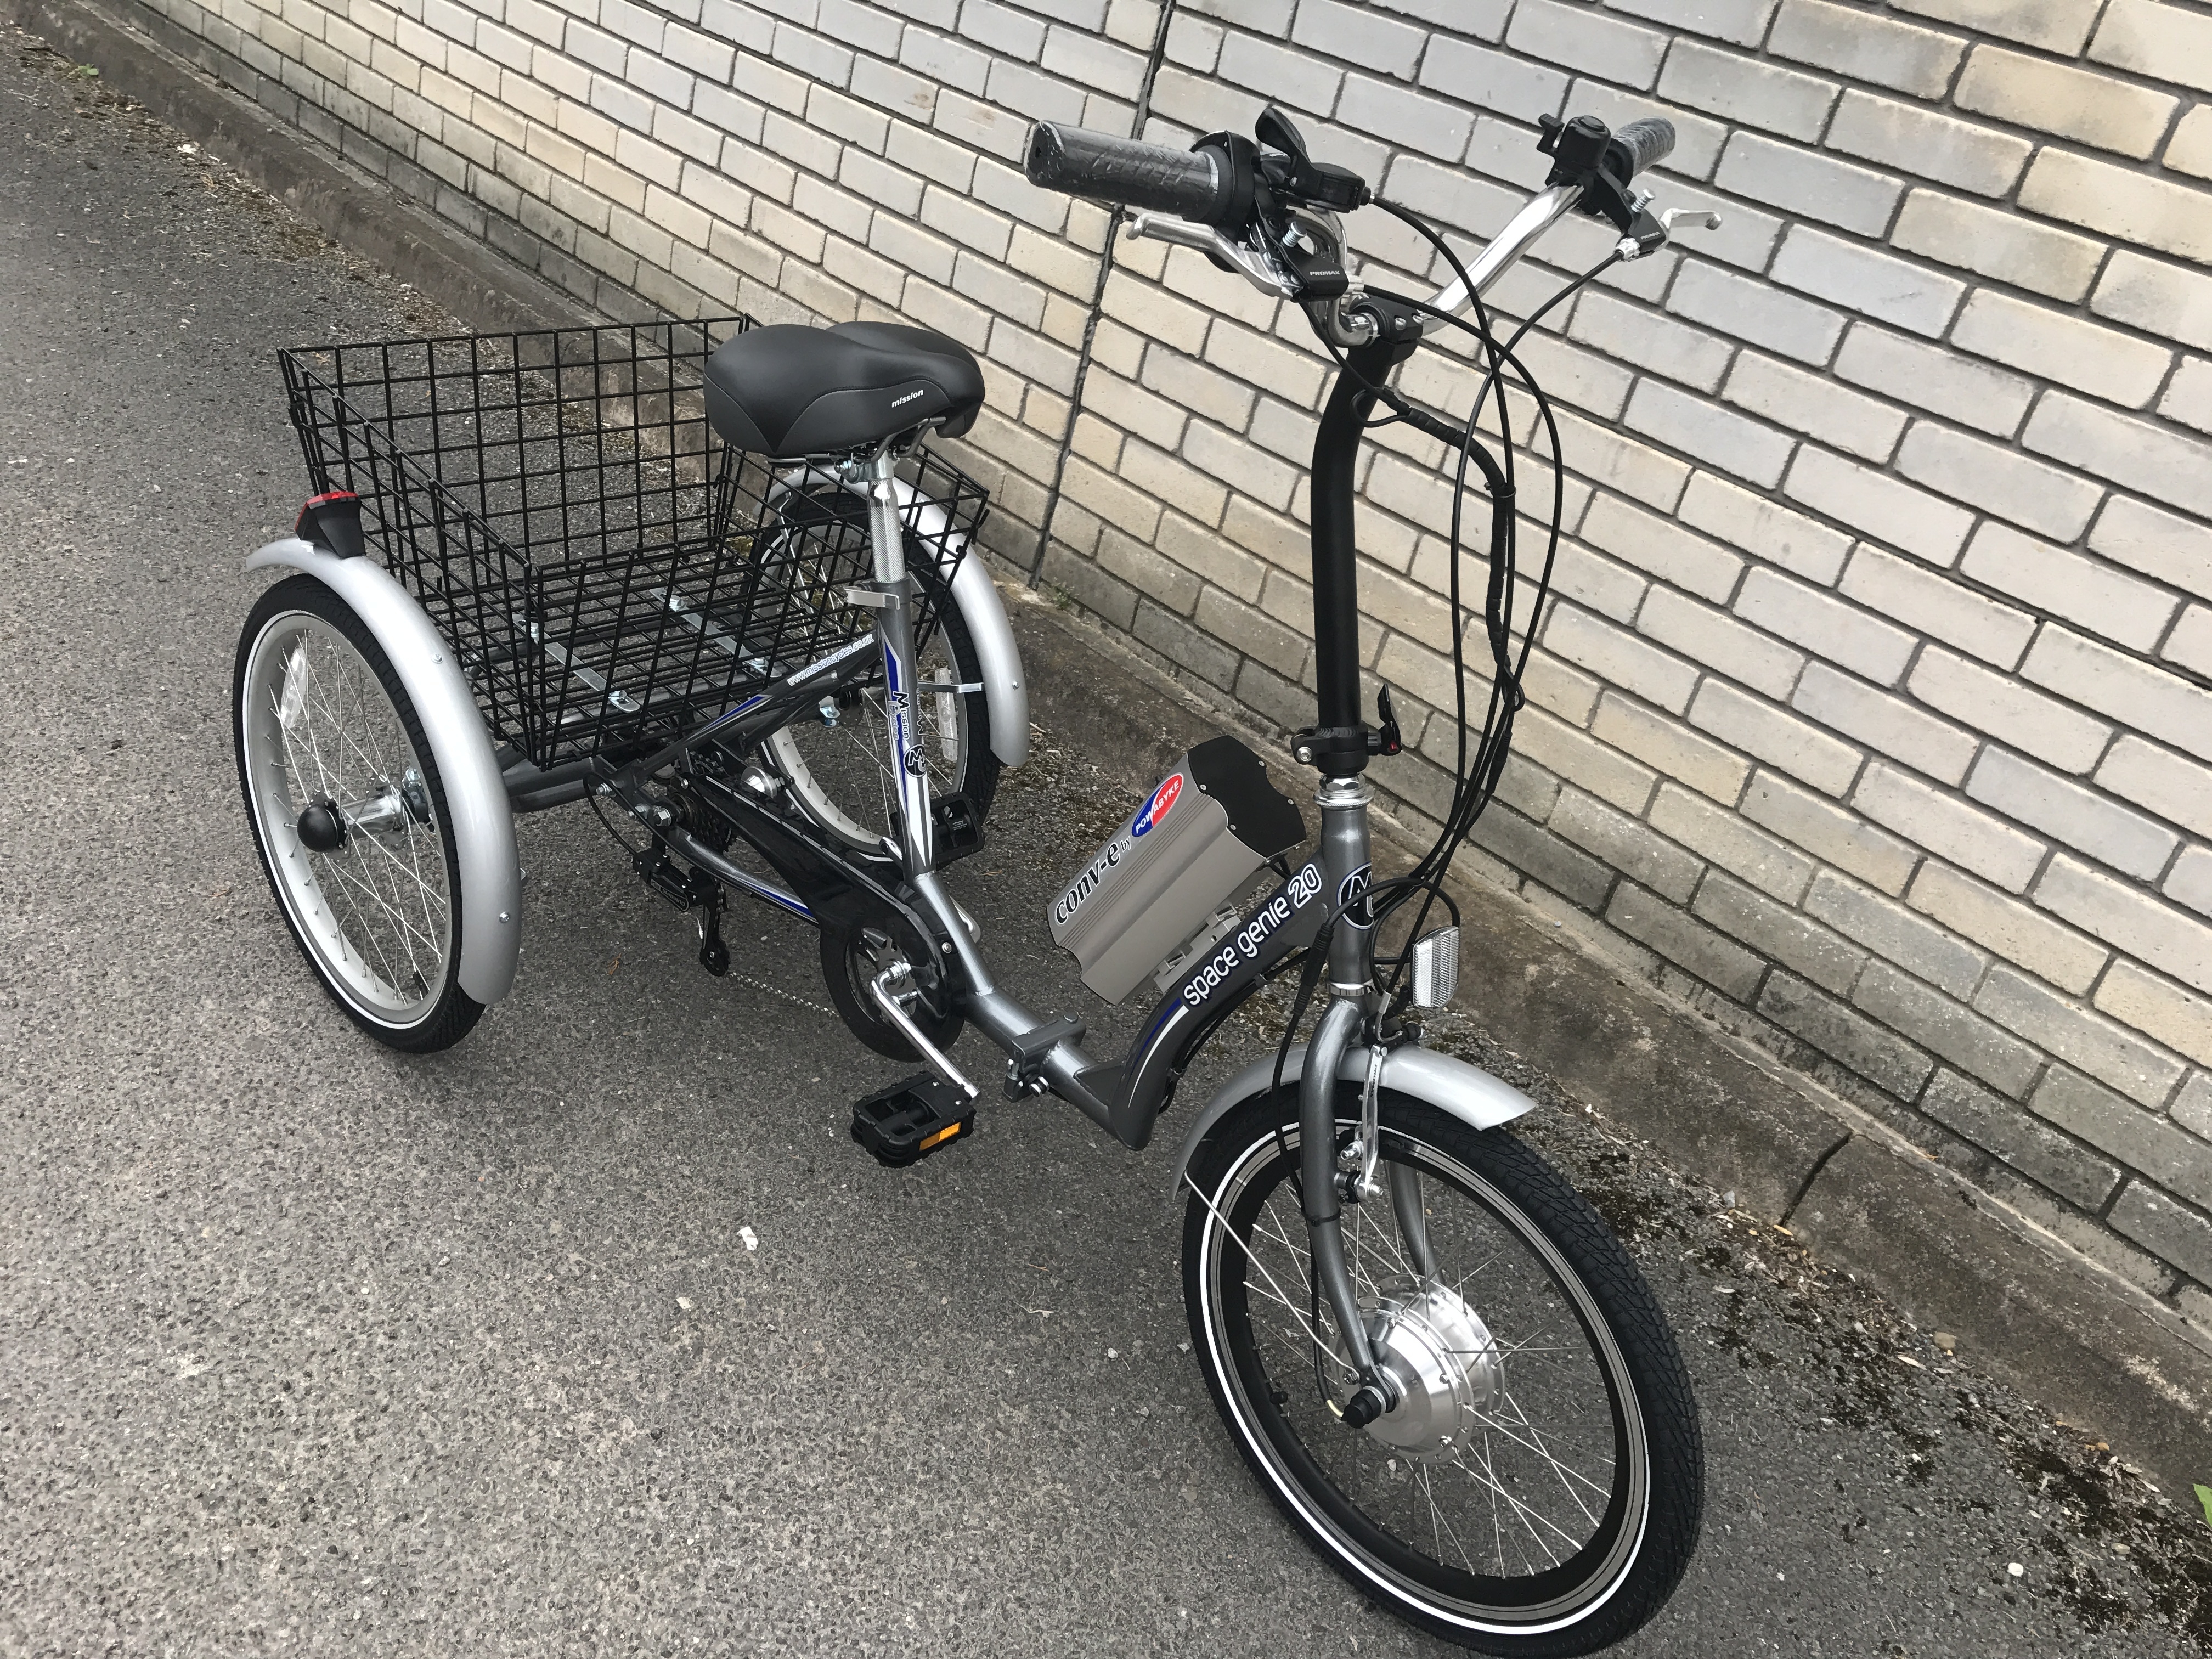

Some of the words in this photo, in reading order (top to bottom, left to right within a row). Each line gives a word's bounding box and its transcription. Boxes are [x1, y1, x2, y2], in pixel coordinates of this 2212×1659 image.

[891, 390, 924, 408] mission
[787, 634, 875, 686] www.missioncycles.co.uk
[887, 700, 900, 741] Cycles
[892, 691, 911, 740] Mission
[1054, 842, 1121, 926] conv-e
[1120, 835, 1132, 853] by
[1135, 779, 1180, 834] POWABYKE
[1183, 945, 1240, 1006] space
[1237, 896, 1291, 958] genie
[1288, 863, 1322, 910] 20
